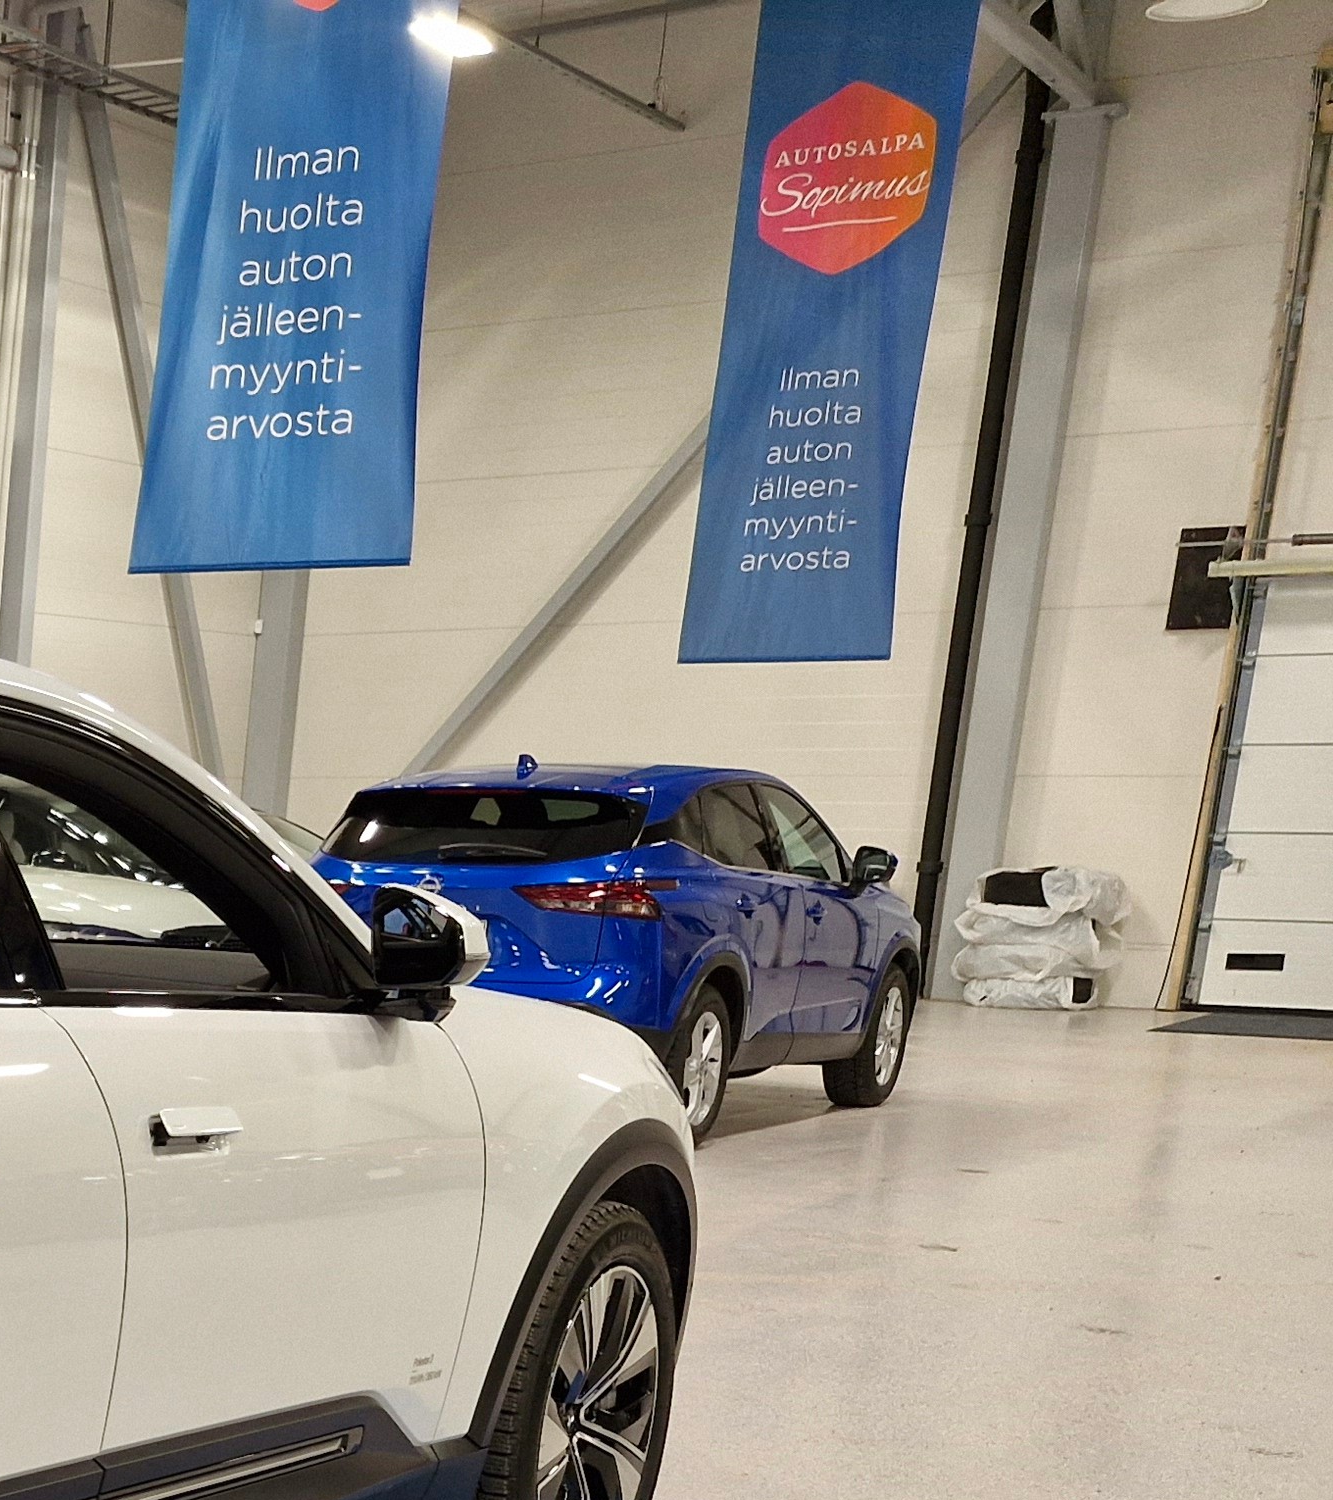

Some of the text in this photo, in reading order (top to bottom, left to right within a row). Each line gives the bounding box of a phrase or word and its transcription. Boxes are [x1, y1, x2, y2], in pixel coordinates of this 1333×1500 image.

[254, 145, 360, 181] Ilman
[775, 132, 925, 169] AUTOSALPA
[760, 169, 931, 219] Sopimus
[240, 192, 364, 234] huolta
[239, 250, 353, 287] auton
[216, 302, 362, 345] jälleen-
[209, 349, 363, 395] myynti-
[780, 366, 860, 391] Ilman
[206, 403, 354, 441] arvosta
[769, 400, 862, 429] huolta
[767, 440, 853, 465] auton
[749, 474, 859, 507] jälleen-
[744, 508, 858, 540] myynti-
[740, 546, 851, 572] arvosta
